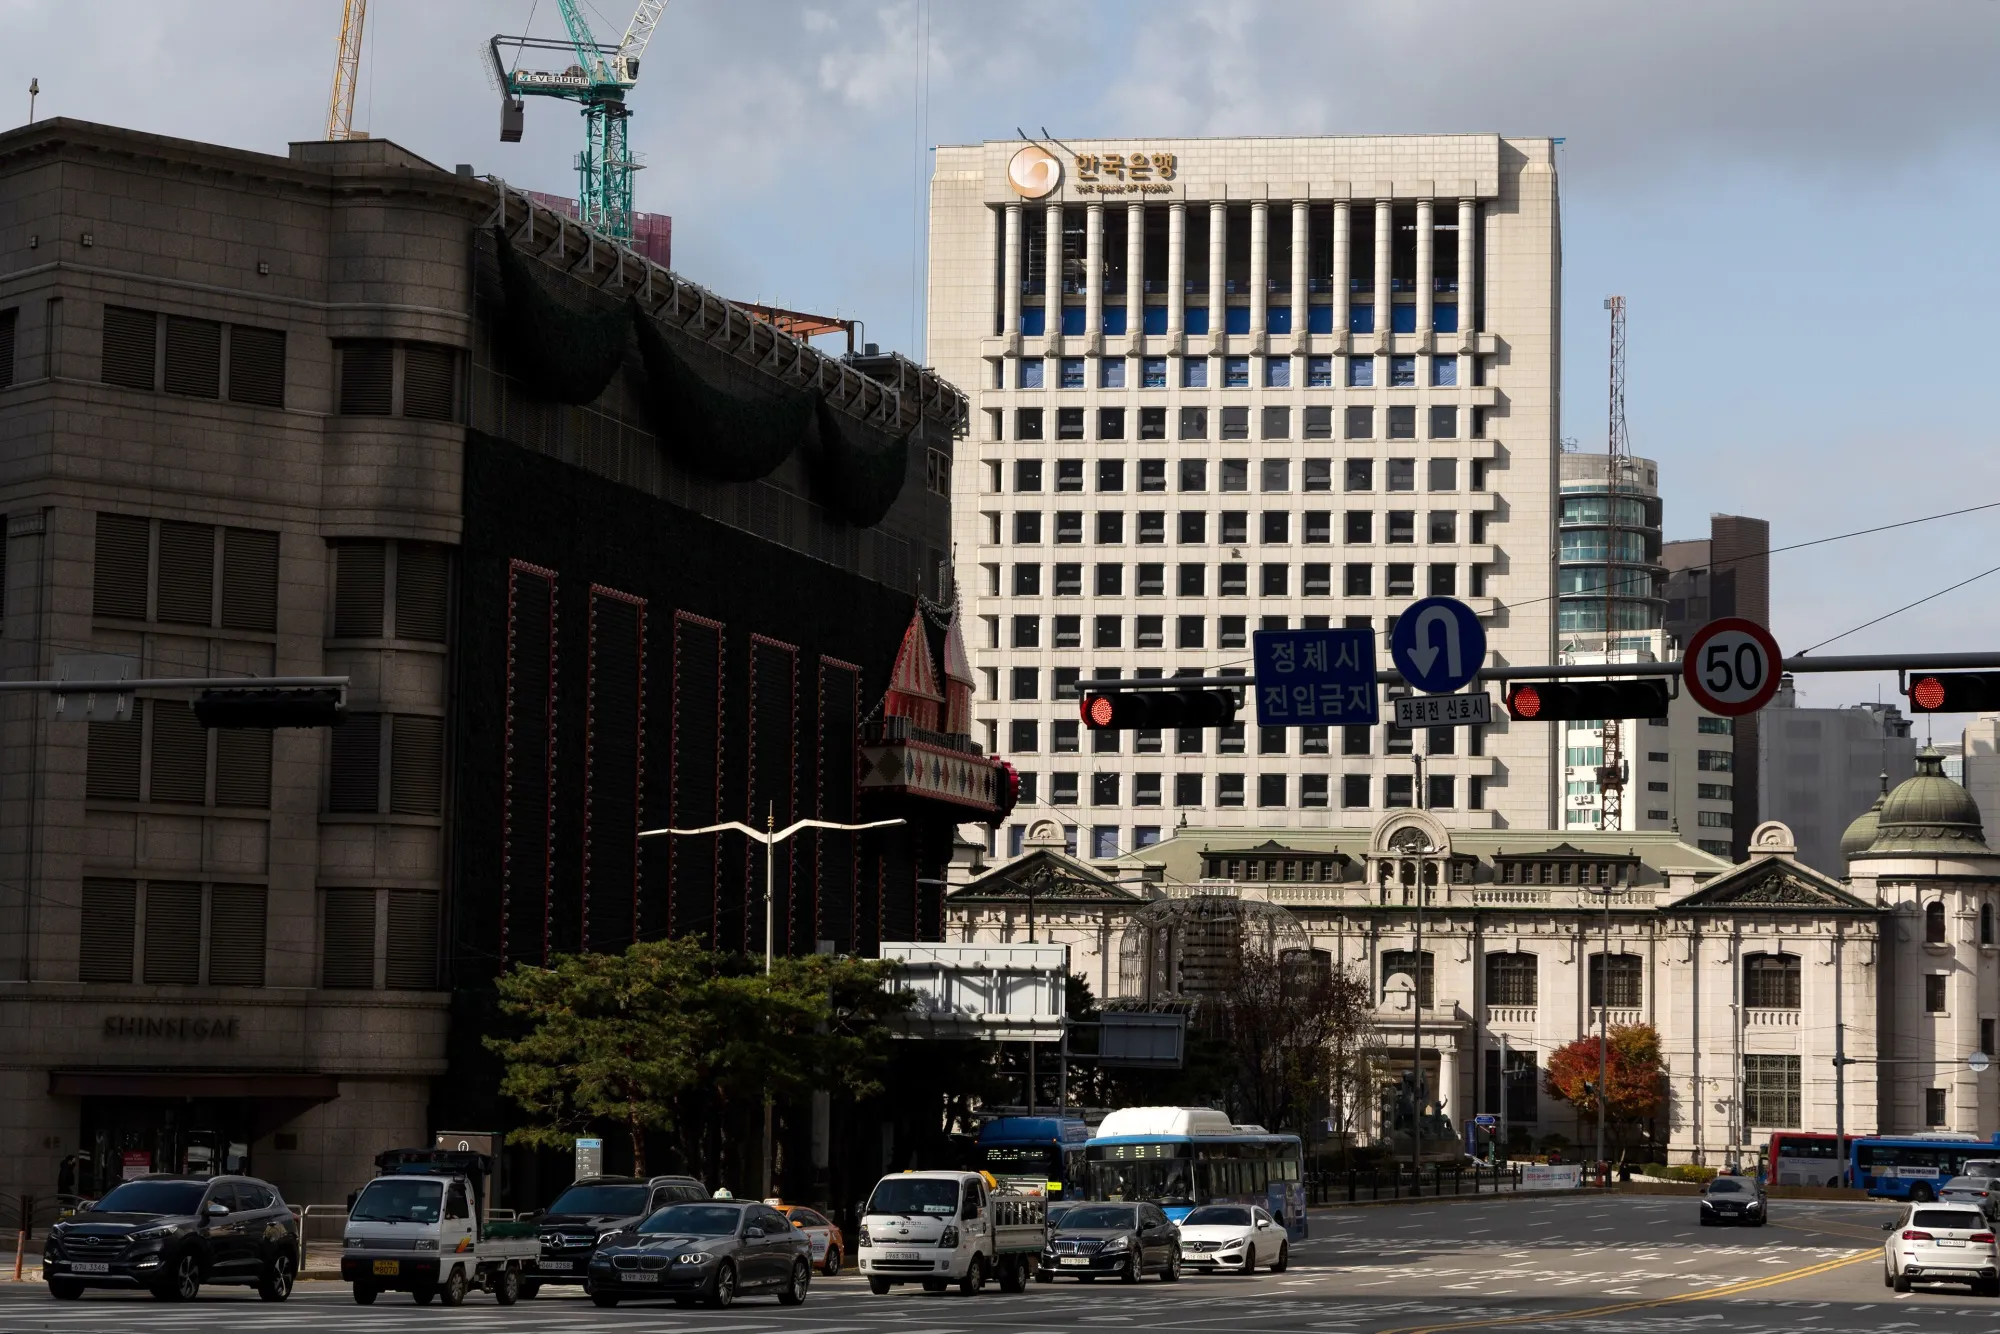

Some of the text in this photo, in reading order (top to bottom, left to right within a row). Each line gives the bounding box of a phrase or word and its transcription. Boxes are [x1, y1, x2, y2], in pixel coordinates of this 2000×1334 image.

[530, 75, 589, 84] EVERDIGM
[1074, 152, 1173, 178] 한국은행
[1271, 639, 1360, 673] 정체시
[1706, 643, 1762, 693] 50
[1264, 682, 1372, 717] 진입금지
[1402, 698, 1484, 722] 좌회전 신호시
[105, 1017, 240, 1039] SHINSEGAE
[1116, 1145, 1161, 1158] 401
